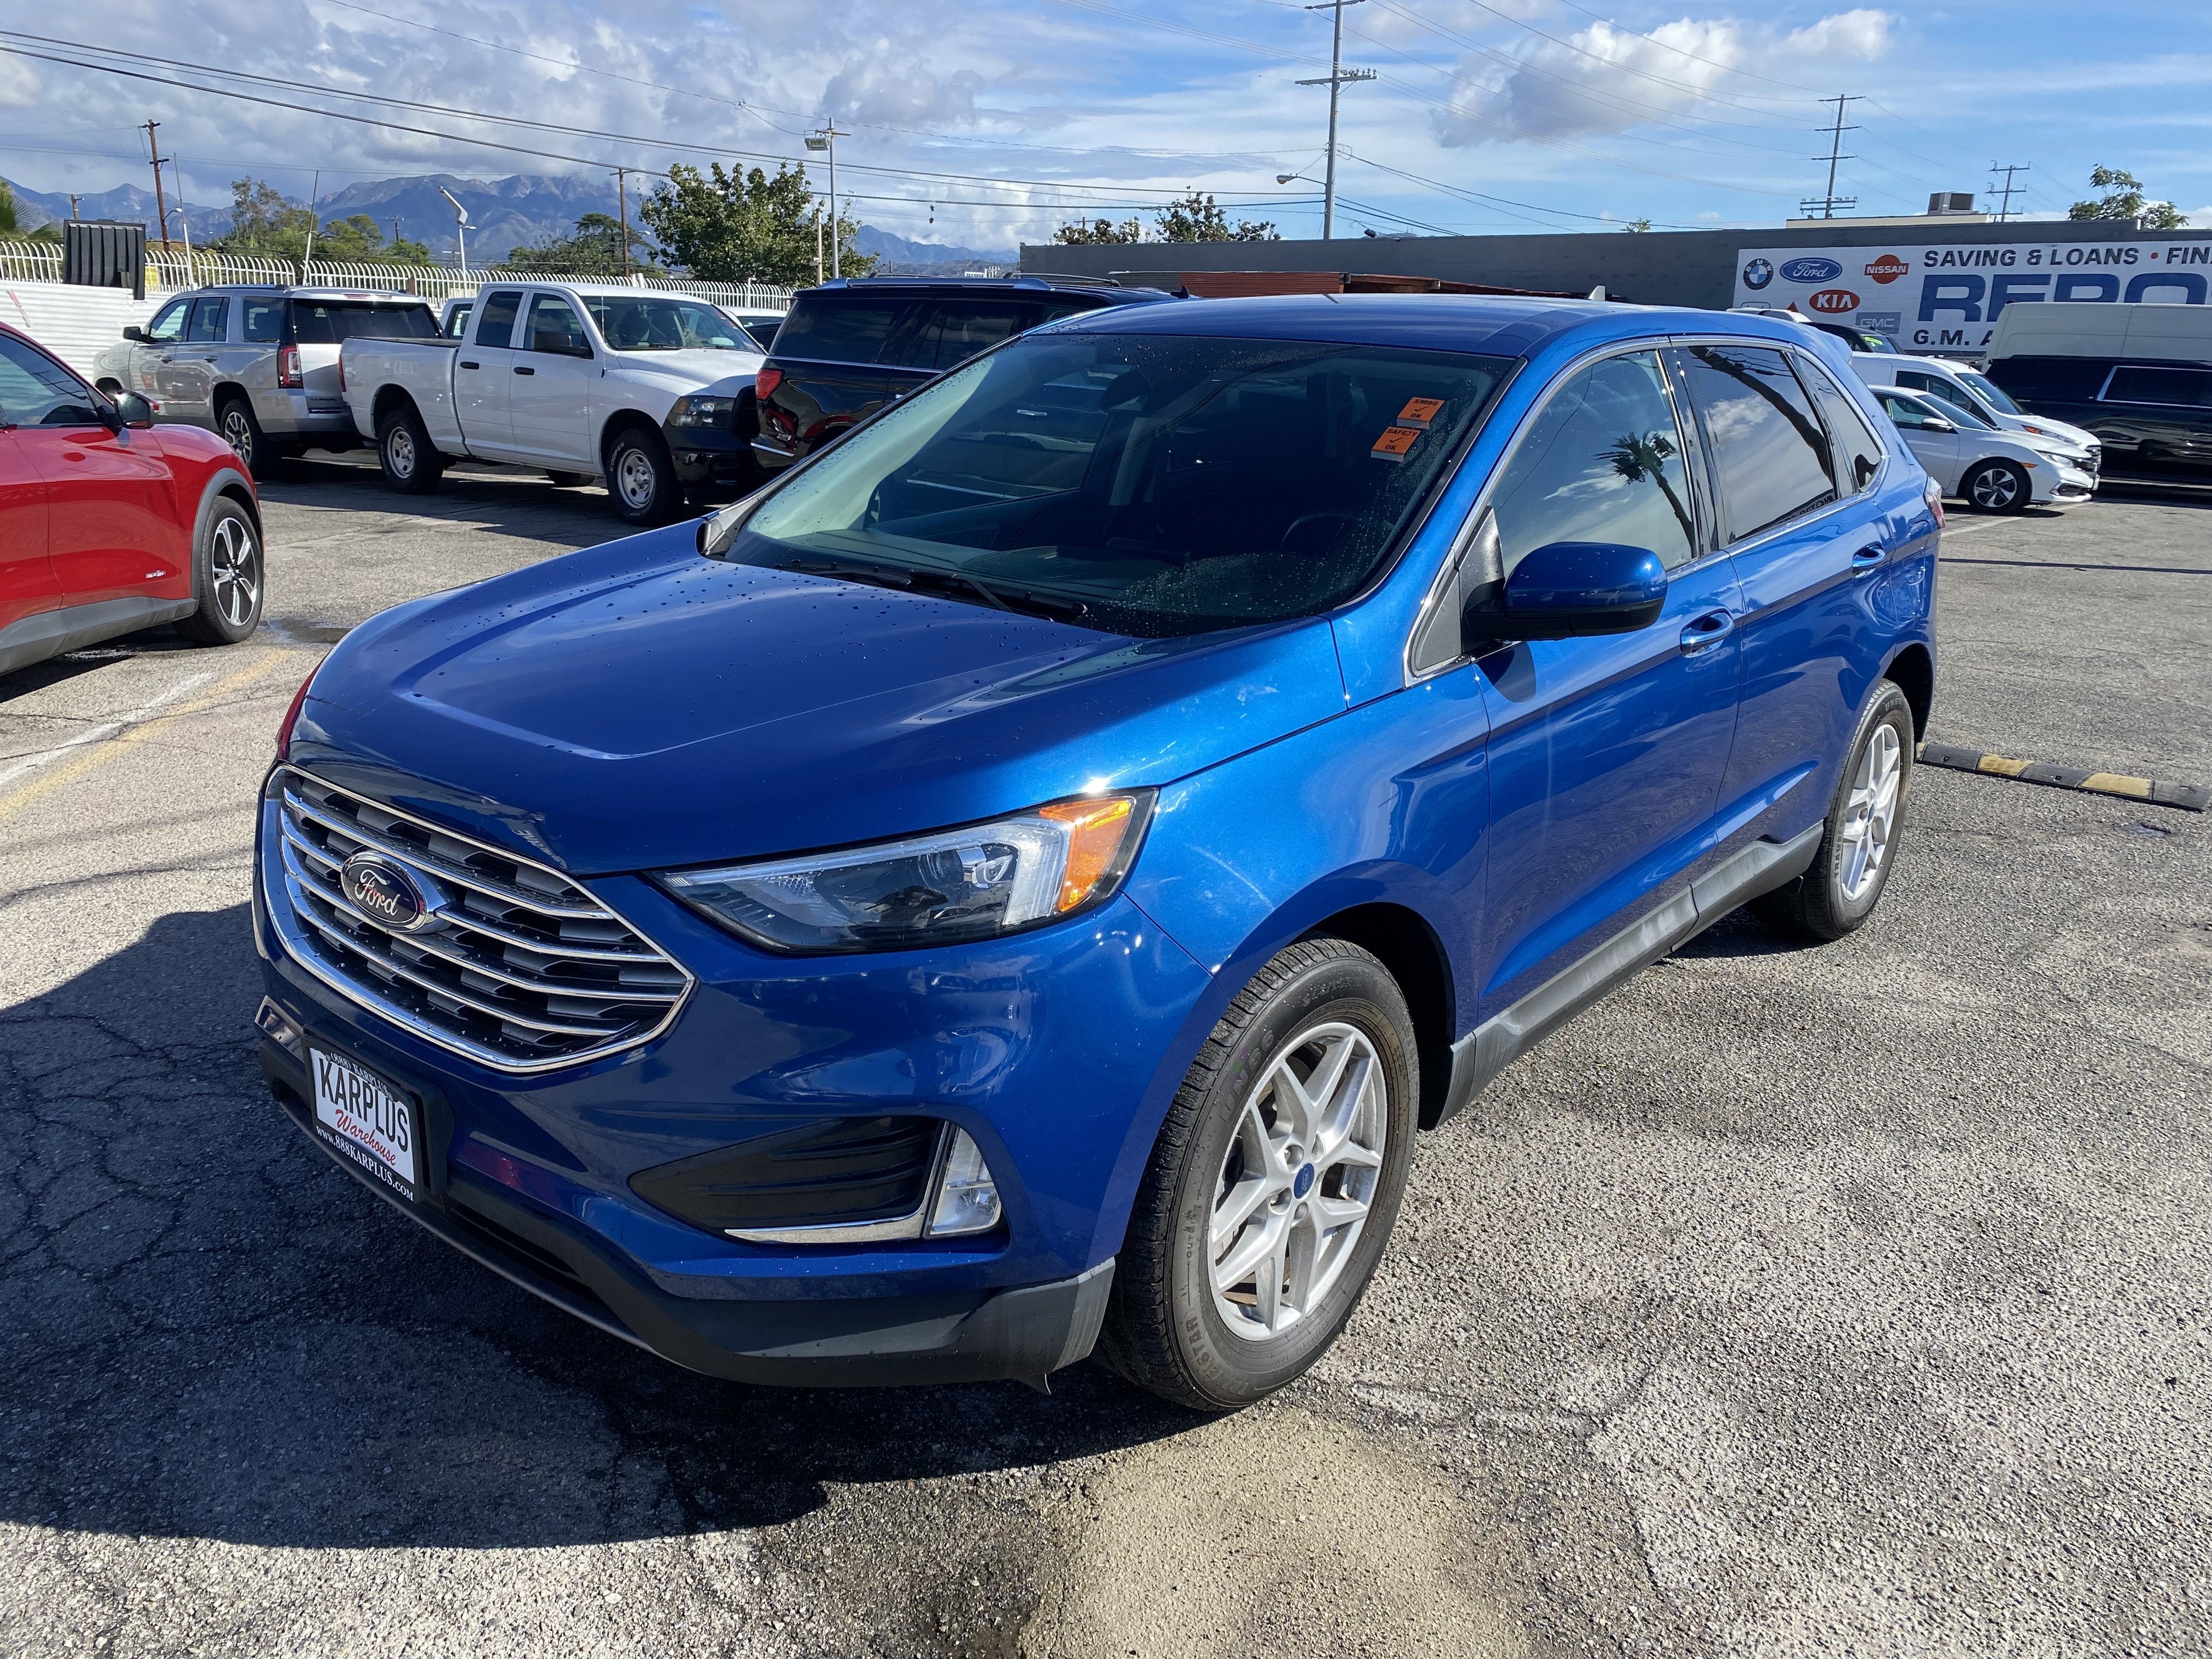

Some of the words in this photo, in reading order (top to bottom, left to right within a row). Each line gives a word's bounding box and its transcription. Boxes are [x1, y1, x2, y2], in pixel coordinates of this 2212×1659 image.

[1923, 250, 2017, 267] SAVING
[2027, 250, 2042, 266] &
[2050, 247, 2139, 265] LOANS
[2166, 246, 2212, 264] FIN
[1746, 259, 1773, 273] BMW
[1793, 262, 1829, 277] Ford
[1866, 265, 1908, 274] NISSAN
[1817, 294, 1853, 308] KIA
[1860, 318, 1895, 328] GMC
[1914, 329, 1970, 346] G.M.
[1386, 428, 1418, 437] SAFETY
[610, 442, 625, 472] COOPER
[354, 868, 401, 916] Ford
[330, 1052, 352, 1070] (888)
[352, 1063, 389, 1097] KARPLUS
[319, 1057, 408, 1153] KARPLUS
[335, 1109, 396, 1166] Warehouse
